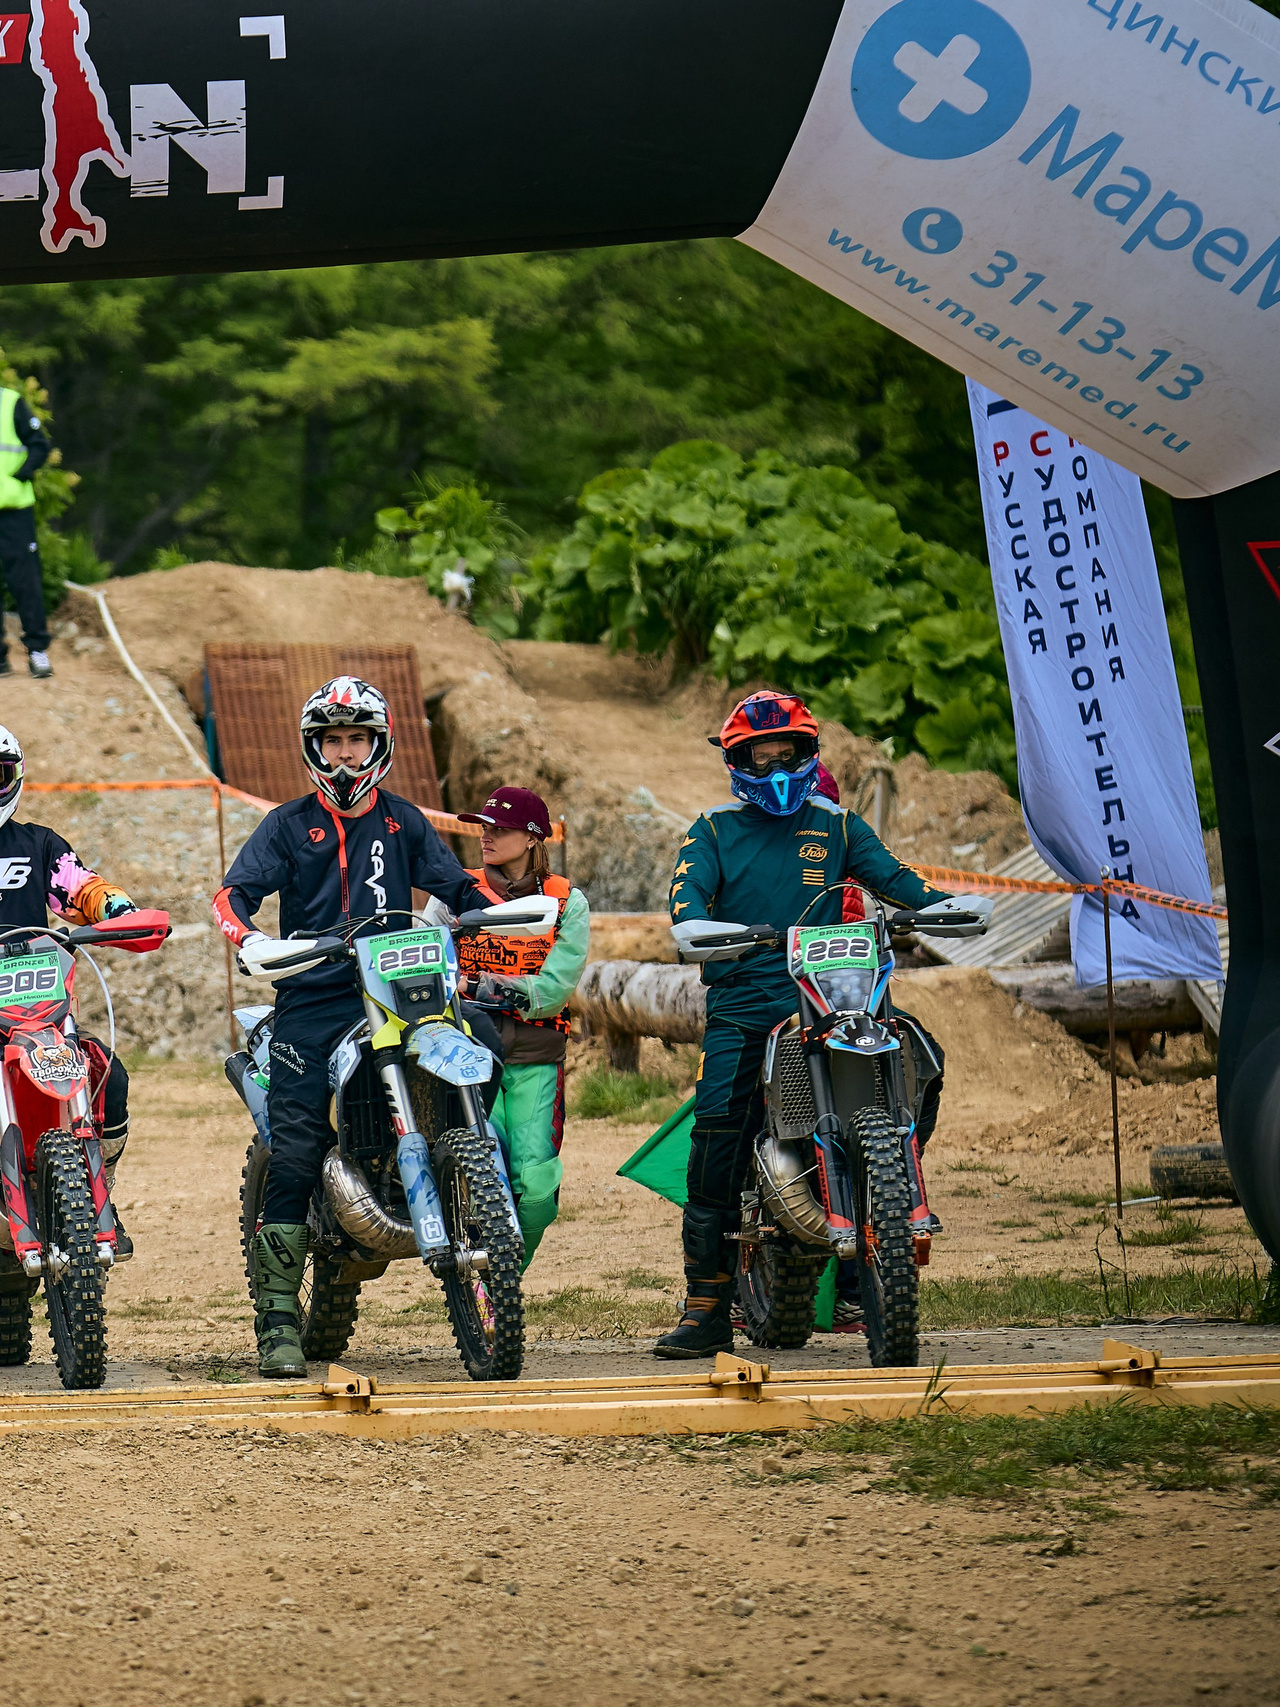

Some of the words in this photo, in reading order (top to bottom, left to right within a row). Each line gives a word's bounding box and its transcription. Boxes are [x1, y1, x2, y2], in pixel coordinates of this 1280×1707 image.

[827, 227, 1192, 455] www.maremed.ru
[969, 249, 1205, 402] 31-13-13
[993, 440, 1049, 655] РУССКАЯ
[1067, 434, 1126, 683] ОМПАНИЯ
[389, 935, 429, 945] BRONZE
[819, 928, 860, 936] BRONZE
[4, 959, 44, 970] BRONZE
[378, 943, 442, 974] 250
[805, 937, 872, 963] 222
